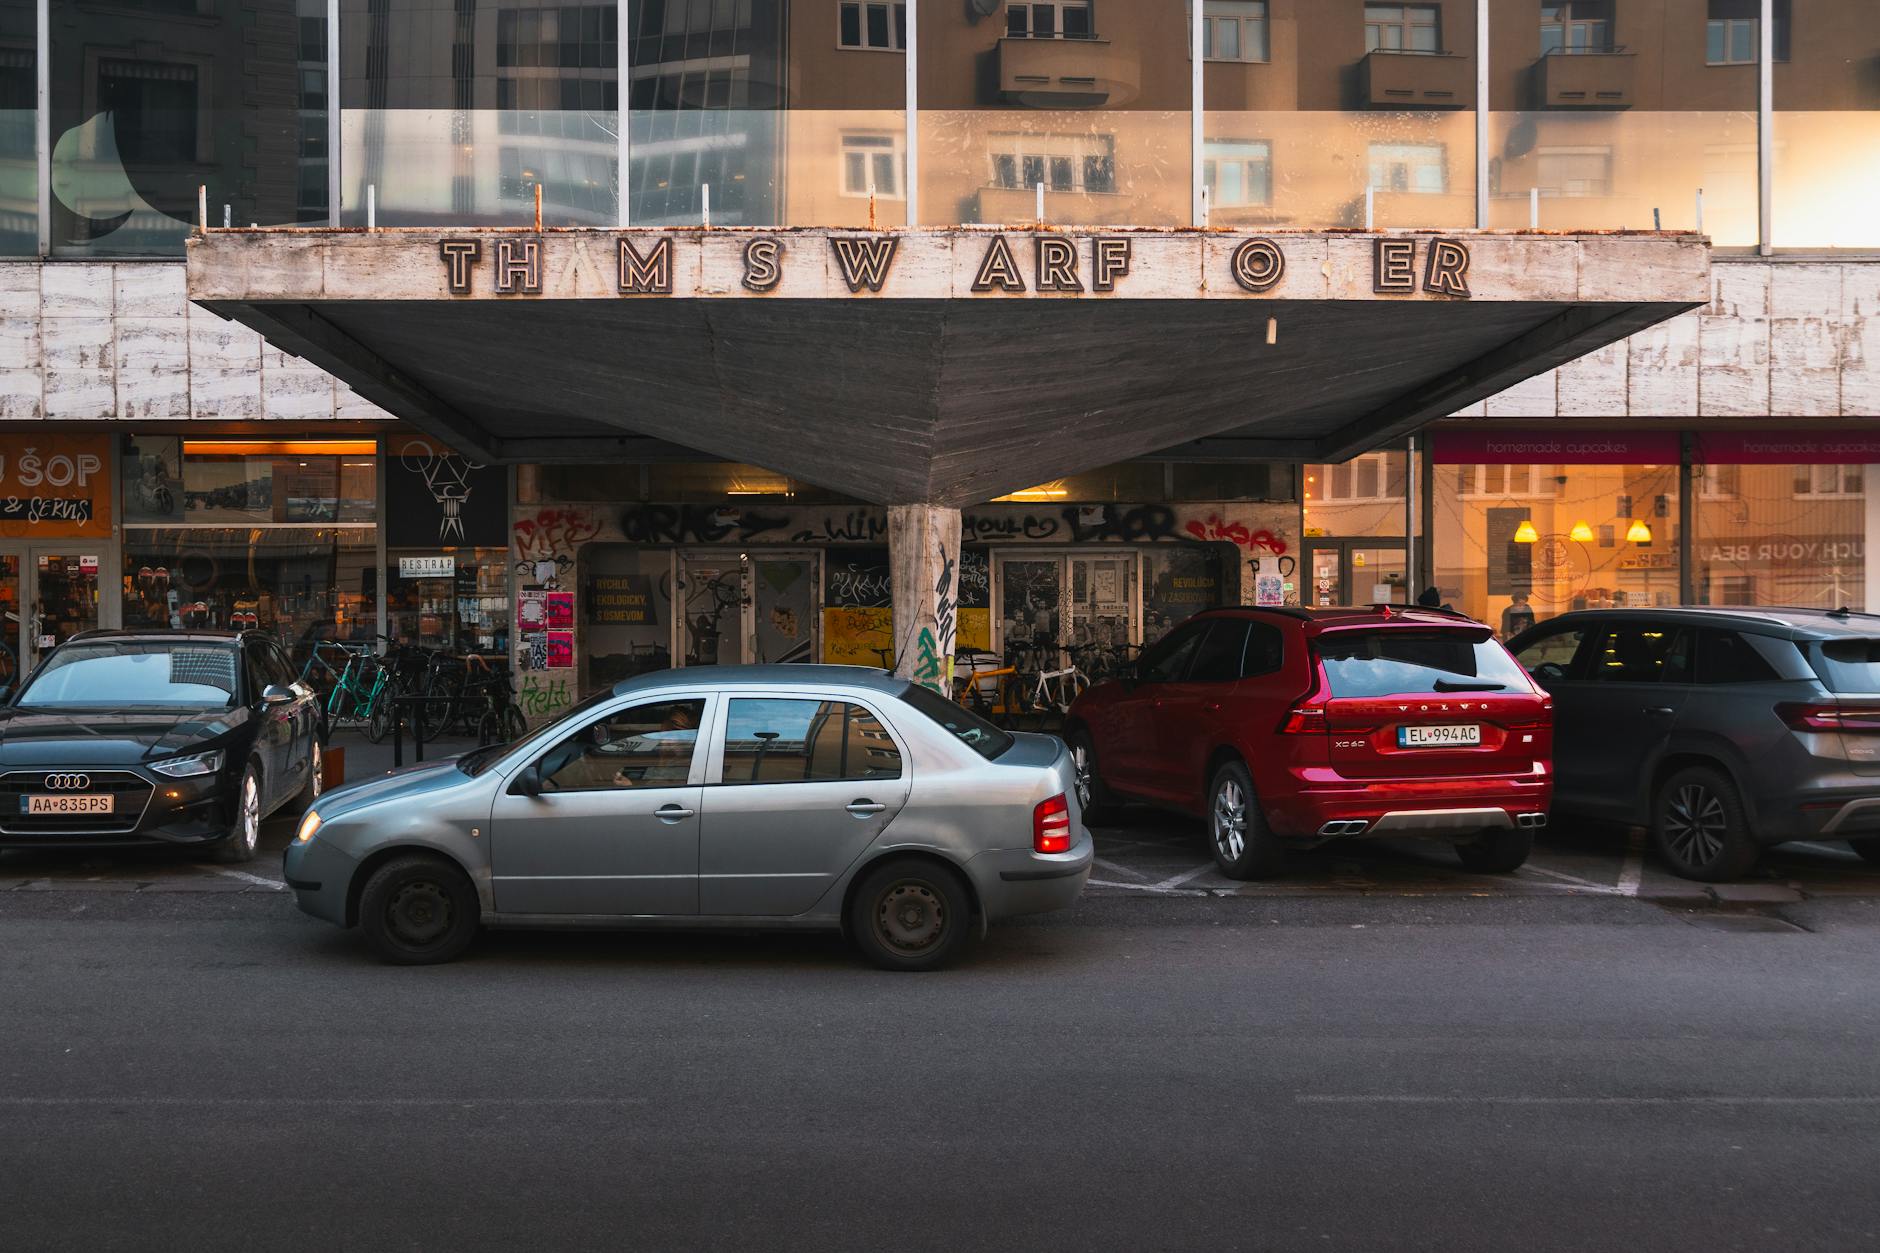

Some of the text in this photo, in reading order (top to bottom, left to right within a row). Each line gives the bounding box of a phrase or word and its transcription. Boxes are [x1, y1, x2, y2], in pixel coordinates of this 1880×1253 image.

[1487, 440, 1628, 456] homemade cupcakes
[1743, 440, 1817, 454] homemade
[18, 447, 102, 487] ŠOP
[402, 559, 452, 570] RESTRAP
[1398, 703, 1487, 711] VOLVO
[1335, 740, 1366, 749] XC60
